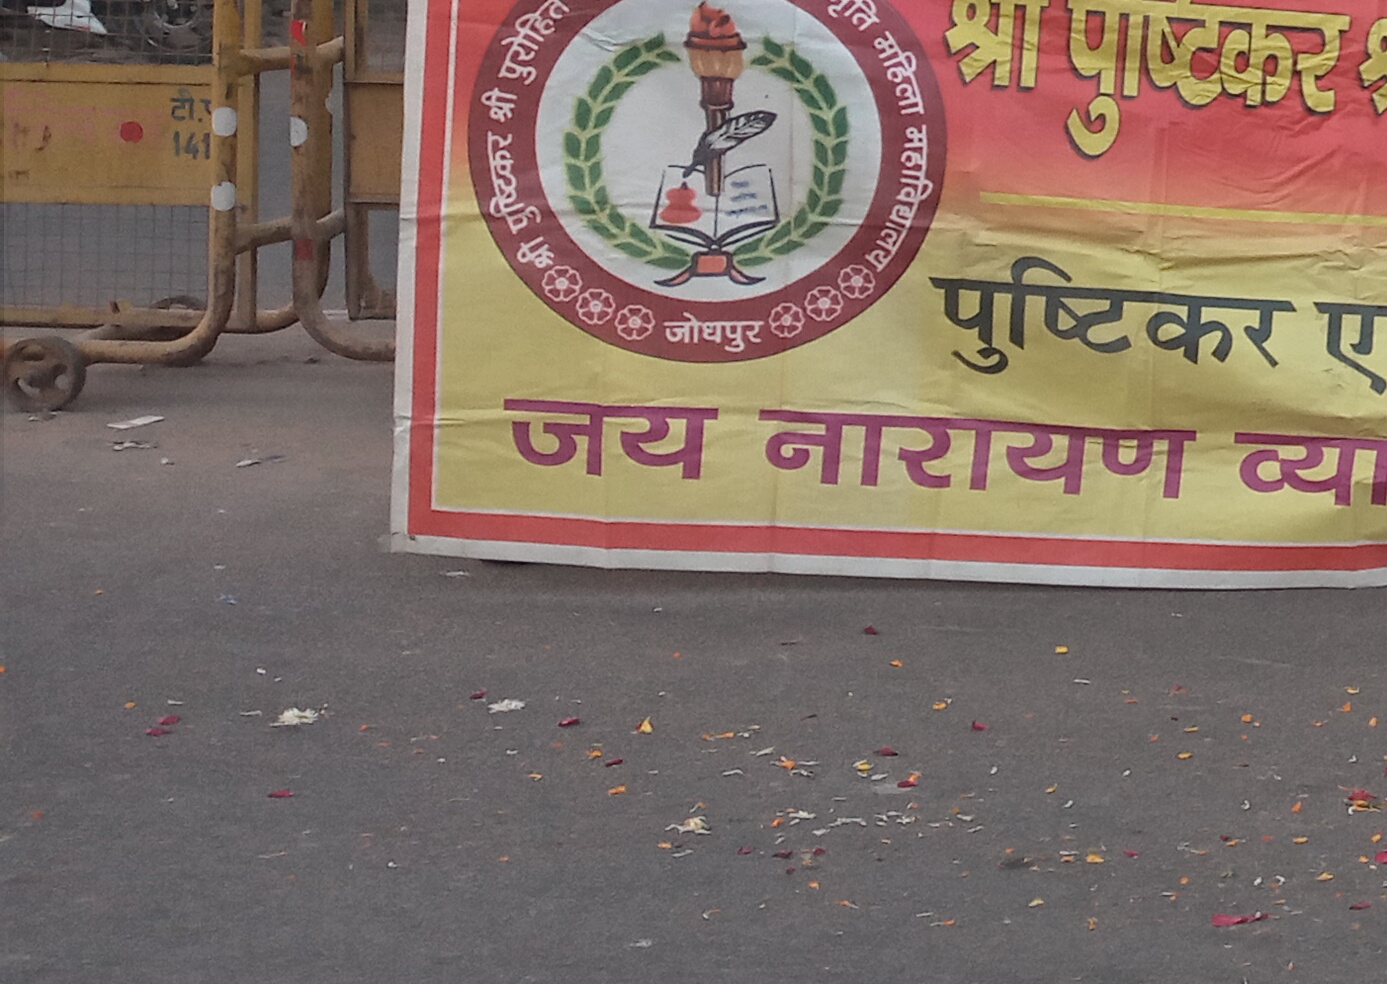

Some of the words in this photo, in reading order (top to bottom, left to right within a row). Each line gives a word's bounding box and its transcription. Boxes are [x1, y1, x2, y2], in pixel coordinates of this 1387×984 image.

[481, 86, 517, 124] श्री
[872, 31, 926, 116] महिला
[864, 123, 934, 273] महाविद्यालय
[663, 311, 765, 353] जोधपुर
[928, 256, 1297, 375] पुष्टिकर
[503, 398, 719, 480] जय
[758, 408, 1197, 500] नारायण
